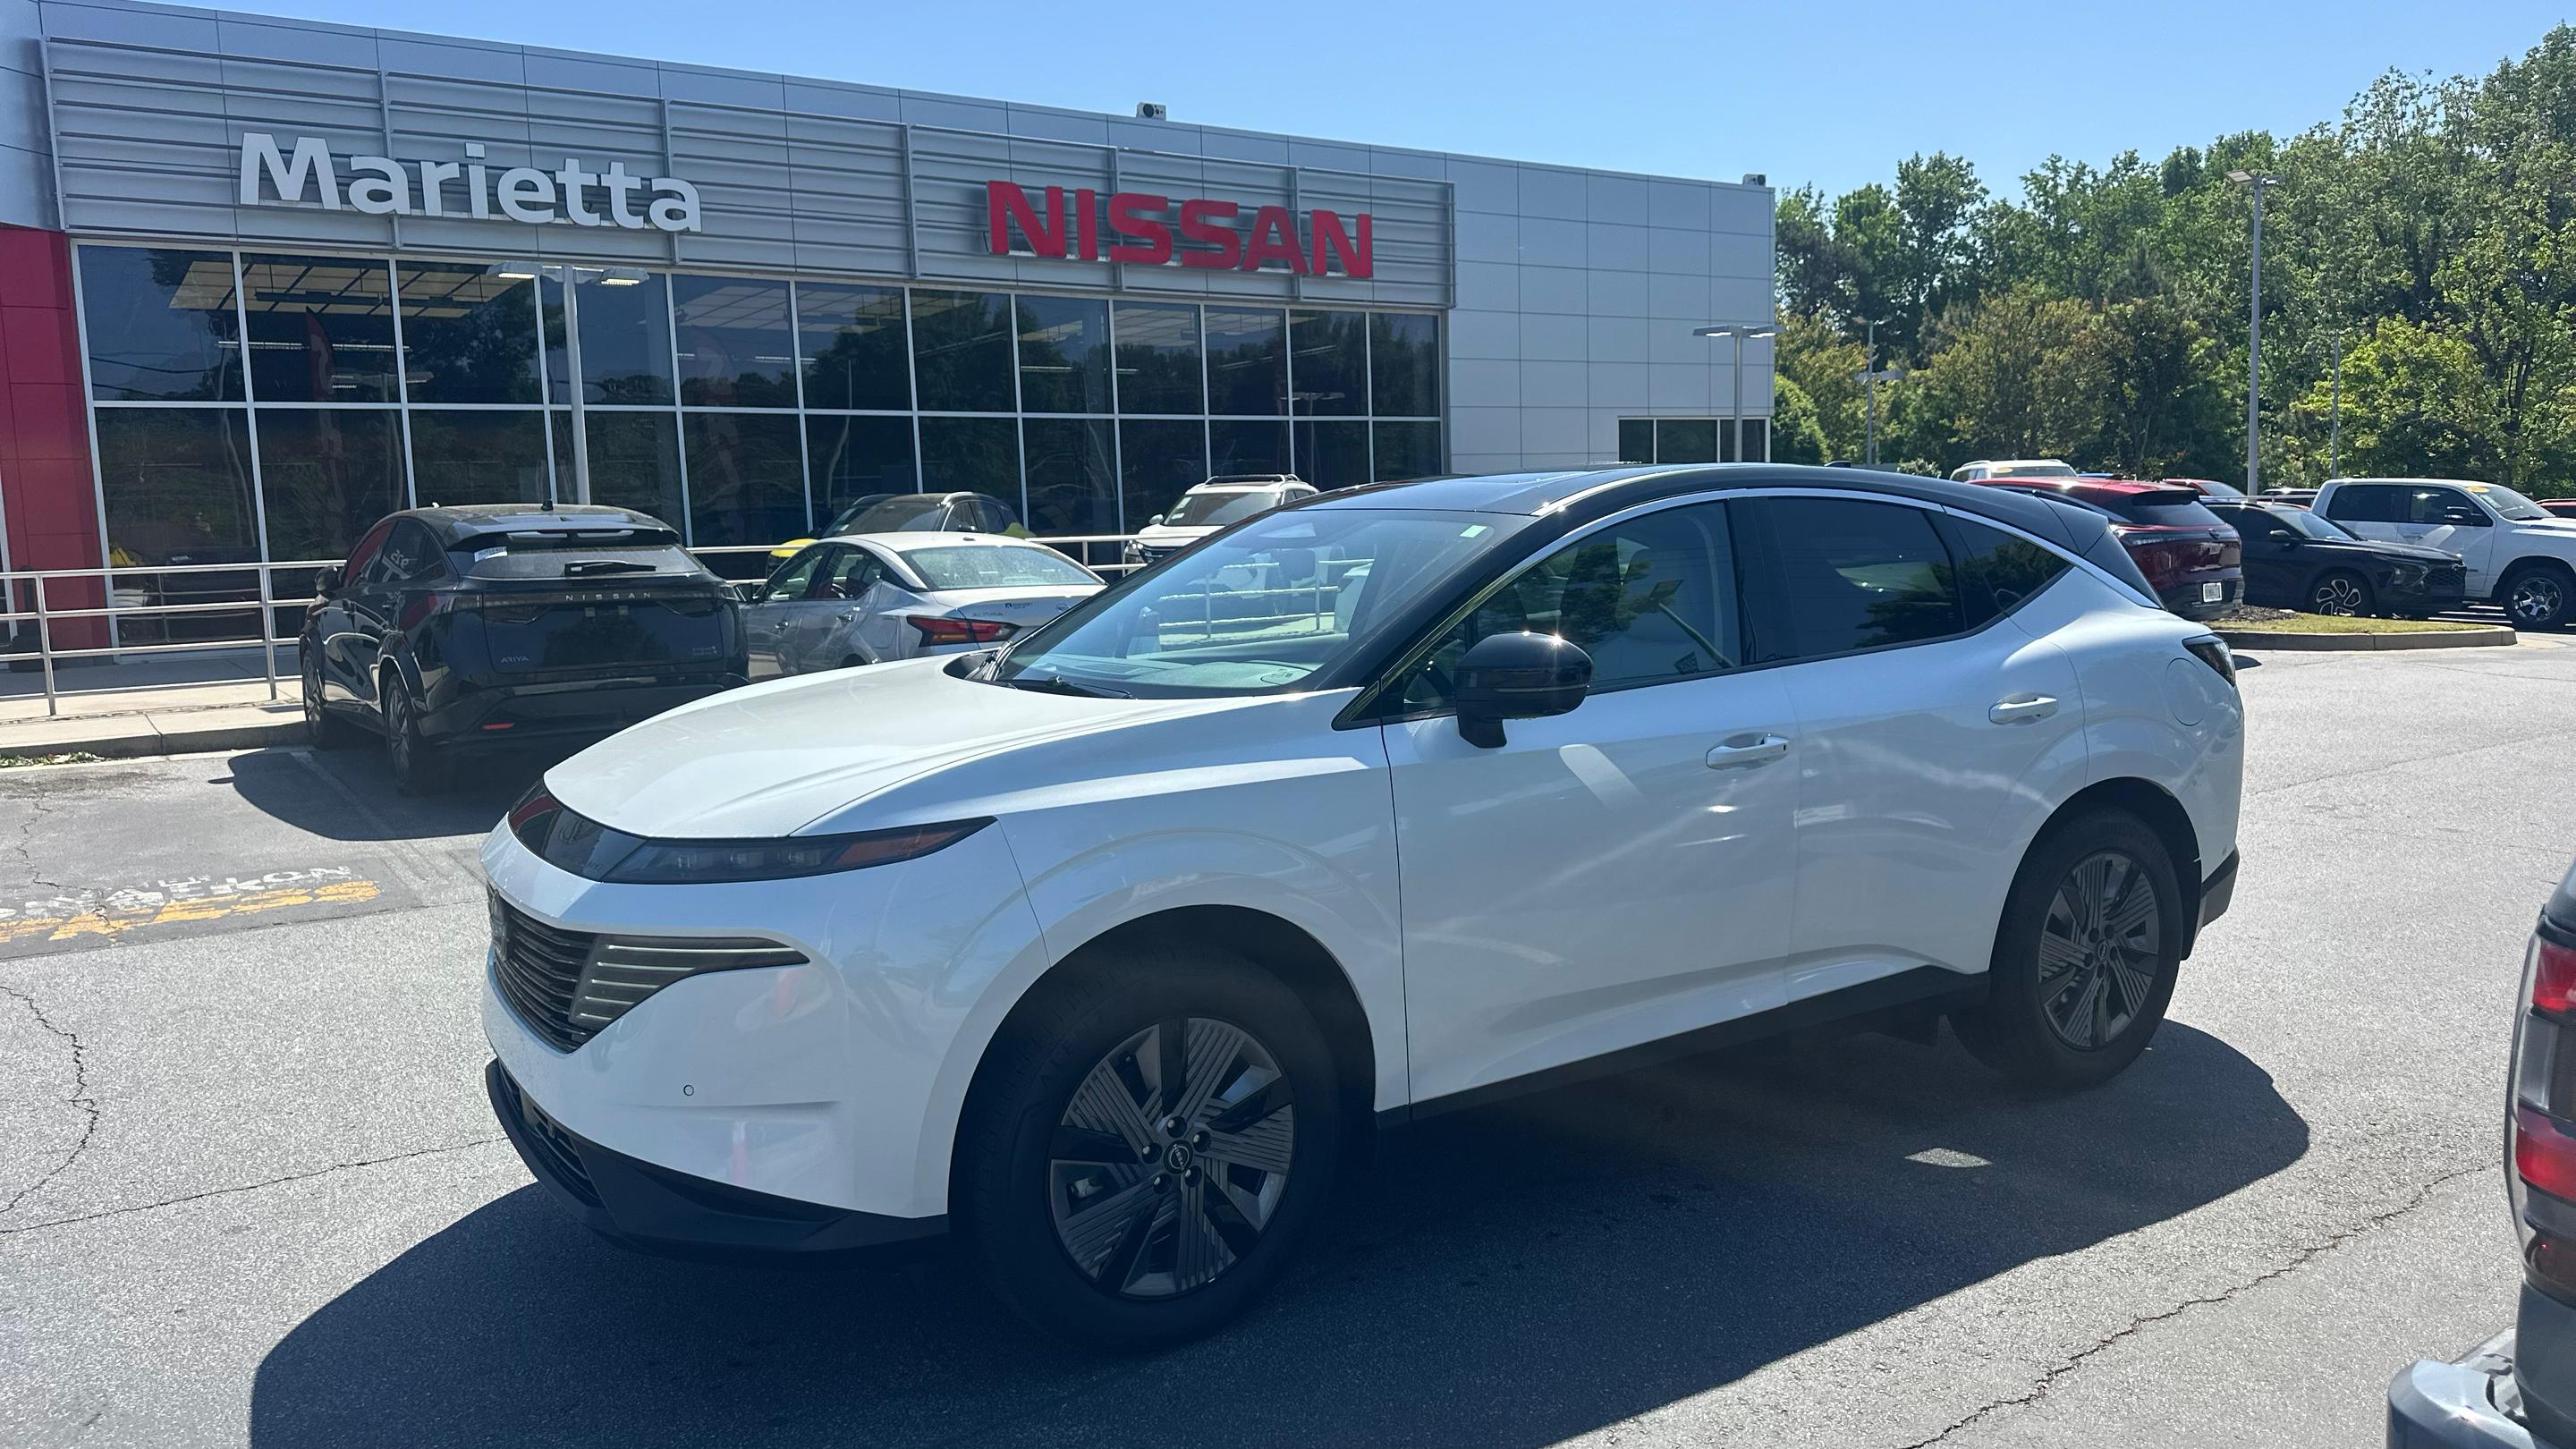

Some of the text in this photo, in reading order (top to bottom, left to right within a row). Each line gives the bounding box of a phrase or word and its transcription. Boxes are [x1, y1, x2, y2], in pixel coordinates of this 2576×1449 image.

[240, 132, 702, 233] Marietta
[987, 180, 1373, 279] NISSAN
[565, 591, 651, 602] NISSAN
[500, 655, 530, 664] ARIYA
